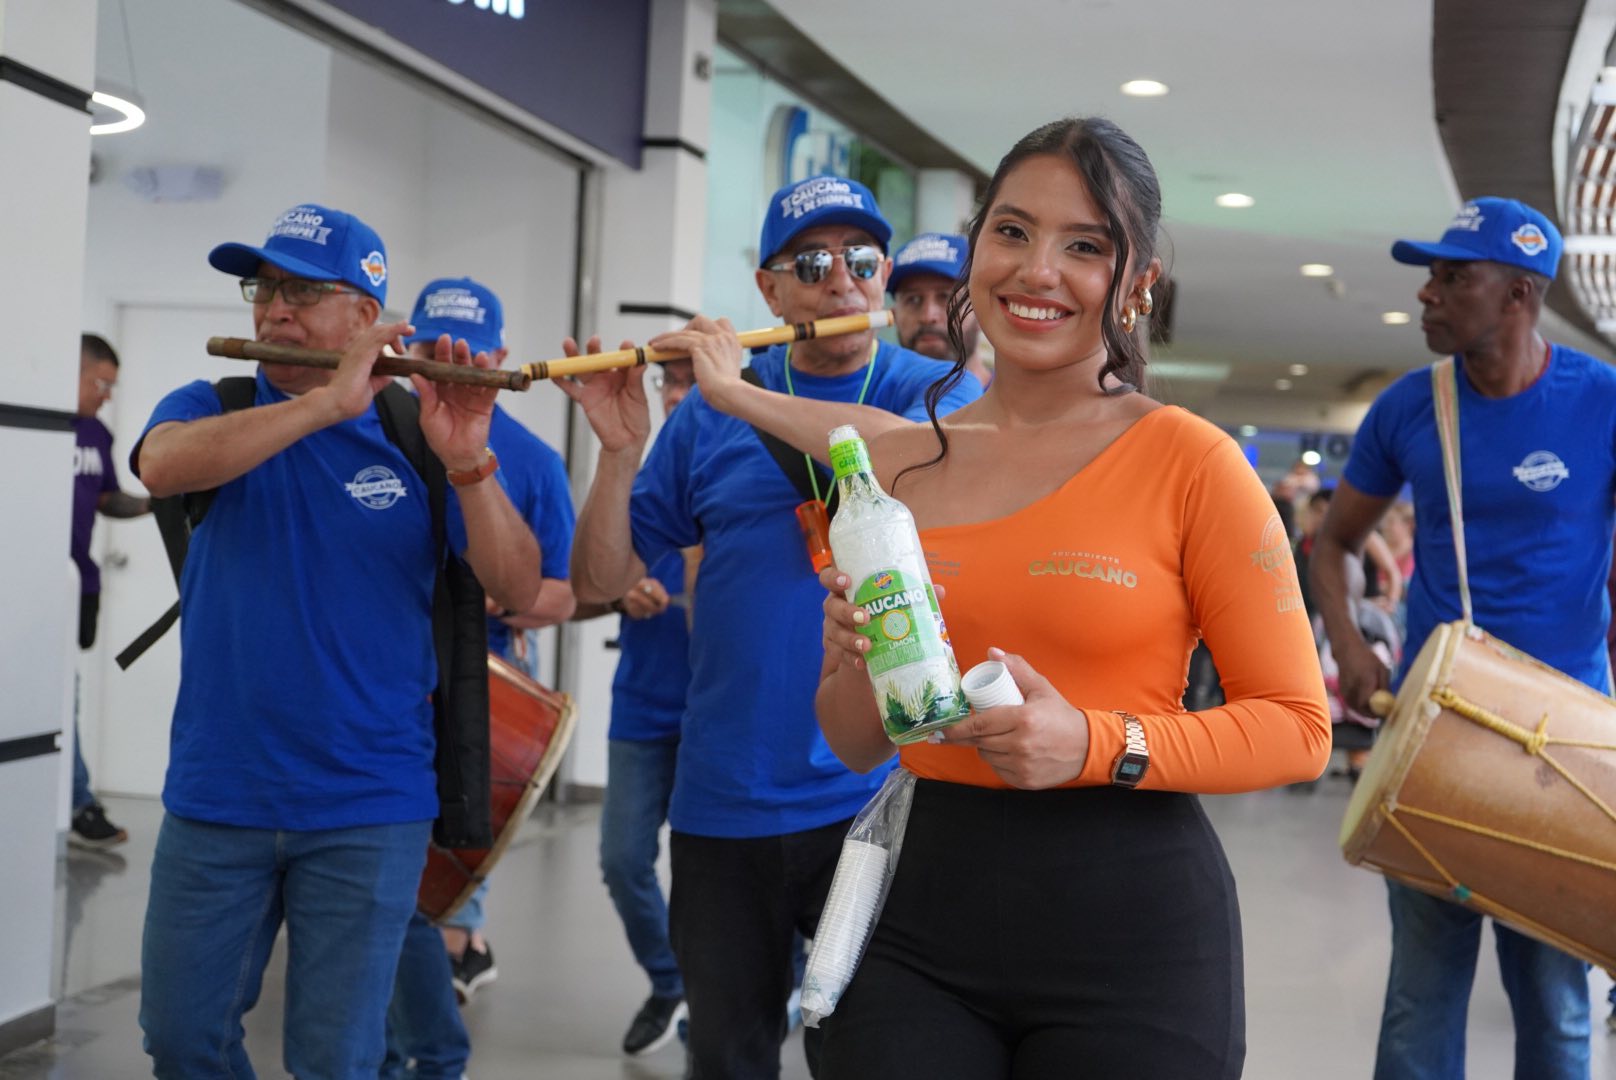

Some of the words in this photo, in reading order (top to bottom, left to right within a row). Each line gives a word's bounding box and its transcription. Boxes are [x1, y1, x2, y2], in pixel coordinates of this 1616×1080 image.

[791, 182, 851, 207] CAUCANO
[353, 480, 400, 494] CAUCANO
[1028, 560, 1137, 588] CAUCANO
[864, 588, 923, 616] AUCANO
